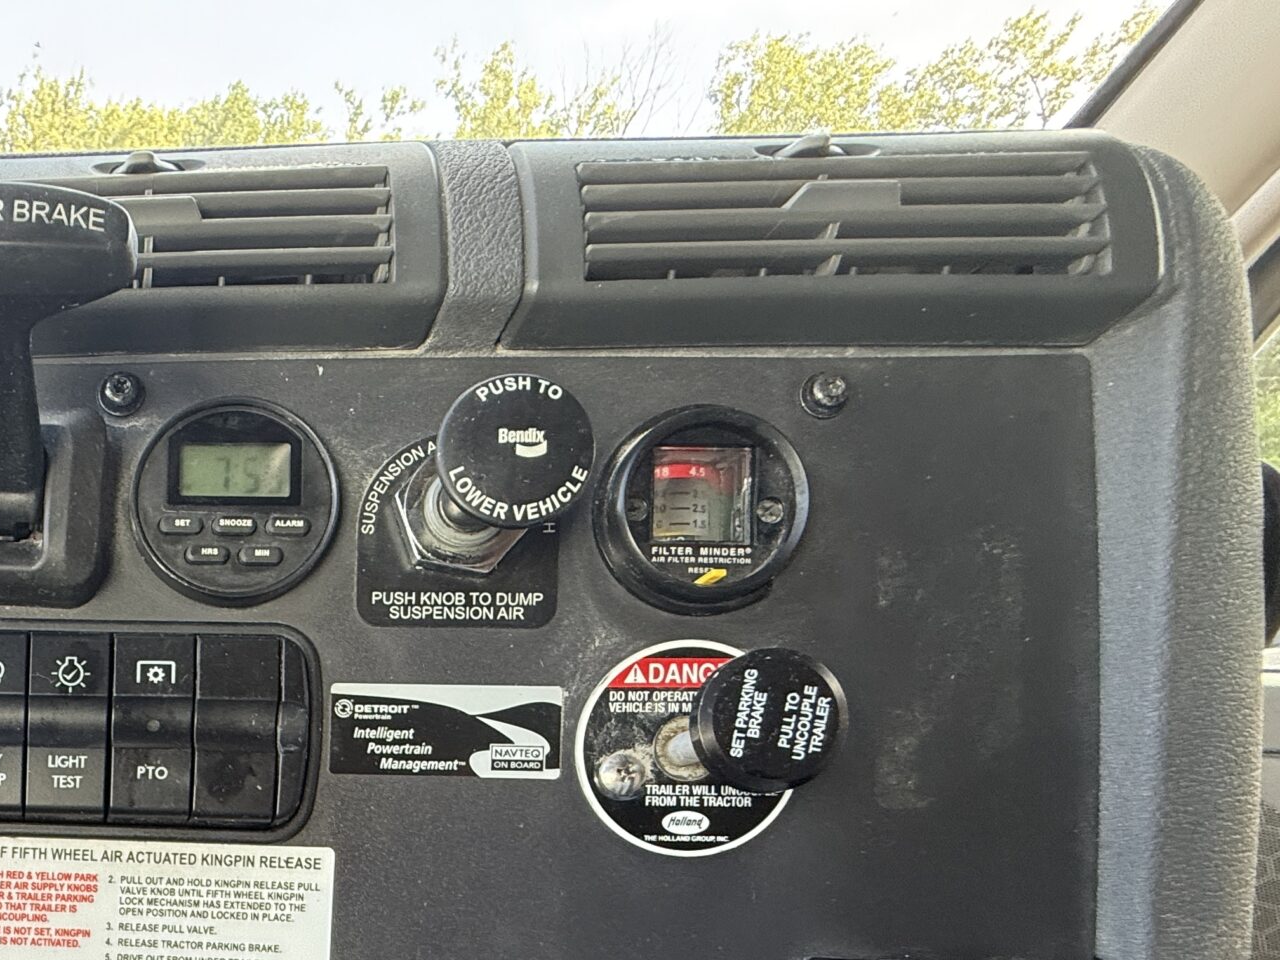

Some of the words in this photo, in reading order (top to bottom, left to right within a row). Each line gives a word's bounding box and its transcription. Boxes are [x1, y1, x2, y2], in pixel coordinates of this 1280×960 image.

[12, 199, 106, 232] BRAKE
[475, 377, 531, 402] PUSH
[537, 378, 563, 400] TO
[498, 428, 545, 444] Bendix
[361, 446, 425, 535] SUSPENSION
[448, 465, 508, 520] LOWER
[512, 465, 588, 521] VEHICLE
[174, 519, 190, 527] SET
[219, 519, 253, 527] SNOOZE
[275, 519, 304, 527] ALARM
[201, 547, 219, 556] HRS
[255, 549, 270, 557] MIN
[651, 546, 693, 555] FILTER
[371, 591, 416, 605] PUSH
[420, 592, 466, 606] KNOB
[470, 592, 491, 606] TO
[496, 592, 544, 606] DUMP
[389, 606, 496, 620] SUSPENSION
[497, 607, 525, 621] AIR
[648, 662, 719, 684] DANG
[609, 691, 625, 702] DO
[628, 691, 650, 702] NOT
[652, 691, 698, 702] OPERAT
[735, 669, 759, 728] PARKING
[784, 692, 800, 712] TO
[608, 702, 652, 713] VEHICLE
[654, 702, 666, 713] IS
[668, 703, 679, 713] IN
[747, 691, 768, 738] BRAKE
[791, 685, 818, 760] UNCOUPLE
[808, 697, 832, 754] TRAILER
[353, 727, 415, 742] Intelligent
[777, 714, 797, 749] PULL
[367, 743, 433, 755] Powertrain
[729, 729, 746, 758] SET
[494, 749, 541, 759] NAVTEQ
[47, 755, 87, 769] LIGHT
[493, 761, 508, 769] ON
[510, 761, 541, 769] BOARD
[136, 766, 169, 780] PTO
[52, 775, 82, 789] TEST
[645, 784, 690, 795] TRAILER
[691, 785, 718, 796] WILL
[645, 796, 677, 807] FROM
[680, 796, 700, 807] THE
[702, 796, 752, 808] TRACTOR
[667, 816, 705, 829] Holland
[658, 834, 690, 842] HOLLAND
[12, 847, 47, 860] FIFTH
[51, 848, 98, 862] WHEEL
[101, 850, 123, 863] AIR
[126, 851, 197, 865] ACTUATED
[201, 853, 255, 867] KINGPIN
[259, 855, 322, 870] RELEASE
[118, 923, 159, 932] RELEASE
[162, 924, 184, 934] PULL
[117, 939, 158, 948] RELEASE
[162, 940, 203, 950] TRACTOR
[207, 942, 245, 951] PARKING
